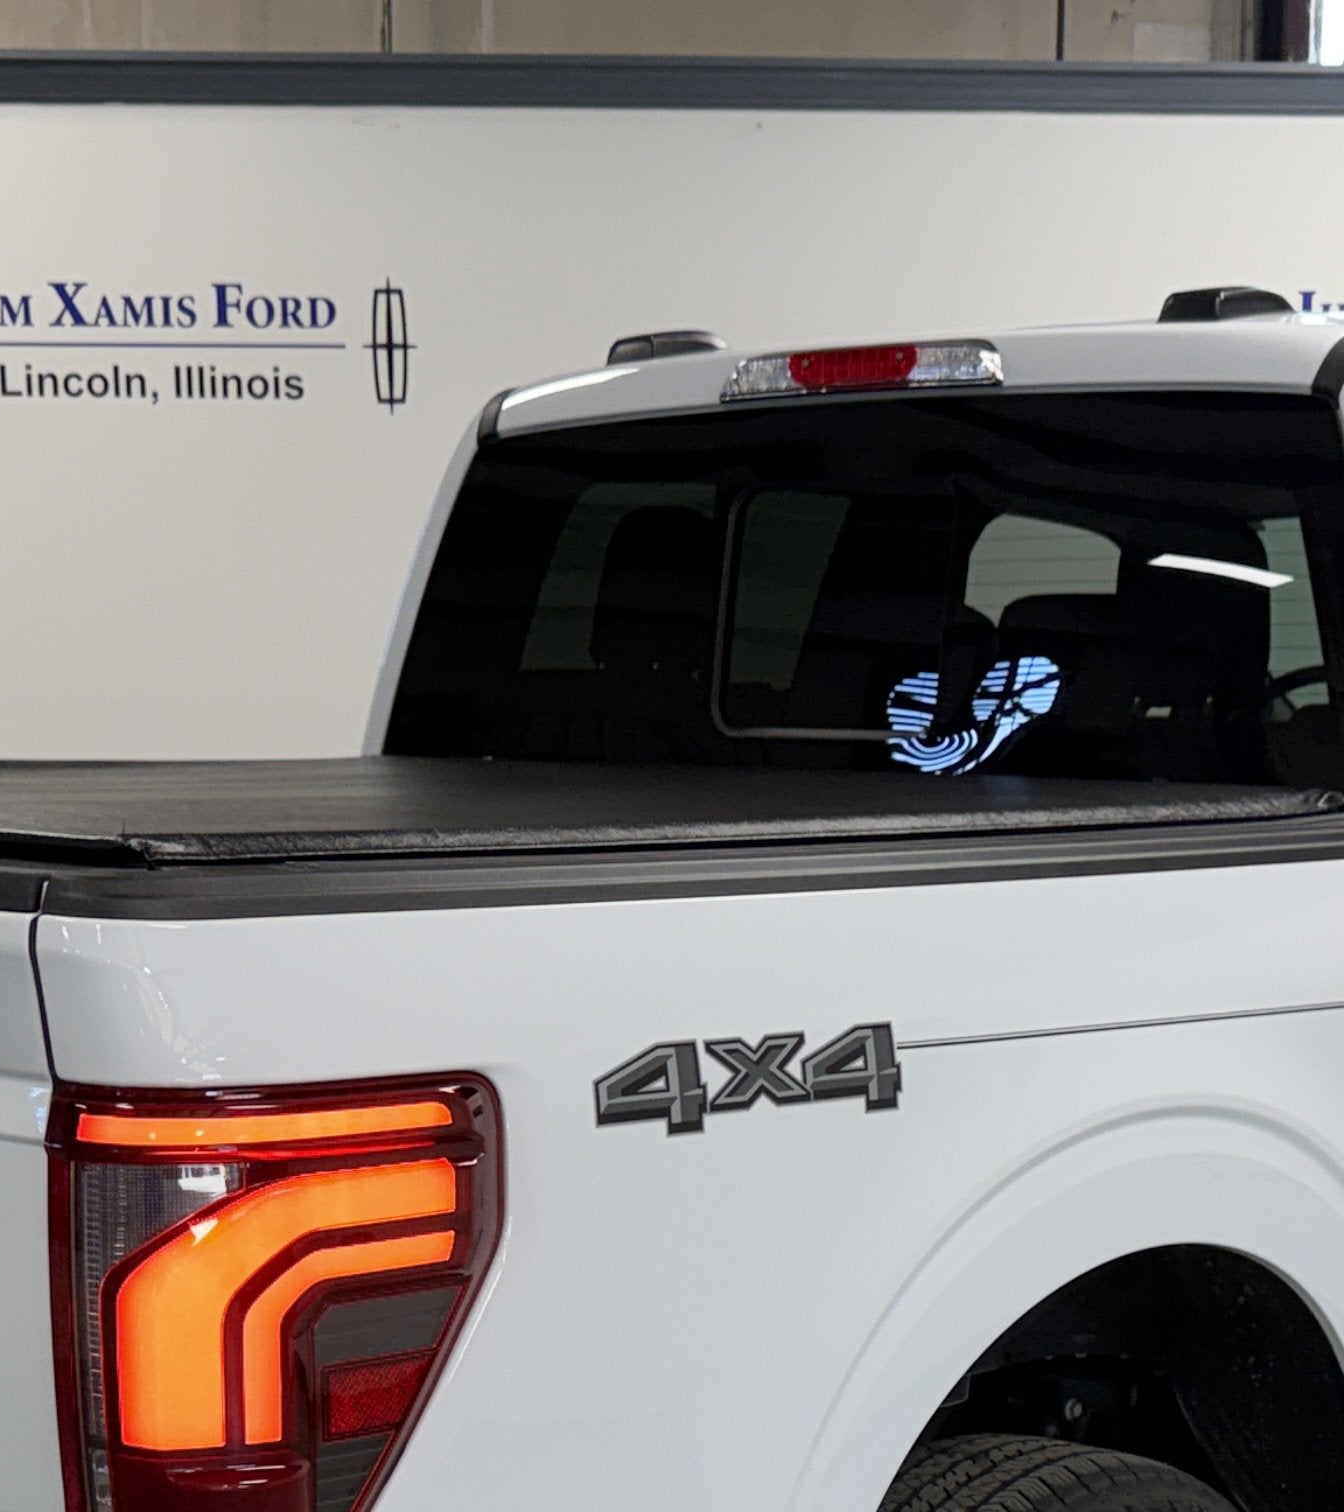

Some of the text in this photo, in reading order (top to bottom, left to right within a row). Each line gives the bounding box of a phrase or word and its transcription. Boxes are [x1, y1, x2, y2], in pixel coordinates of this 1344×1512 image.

[47, 282, 199, 329] XAMIS
[212, 283, 337, 330] FORD
[0, 364, 305, 405] Lincoln, Illinois
